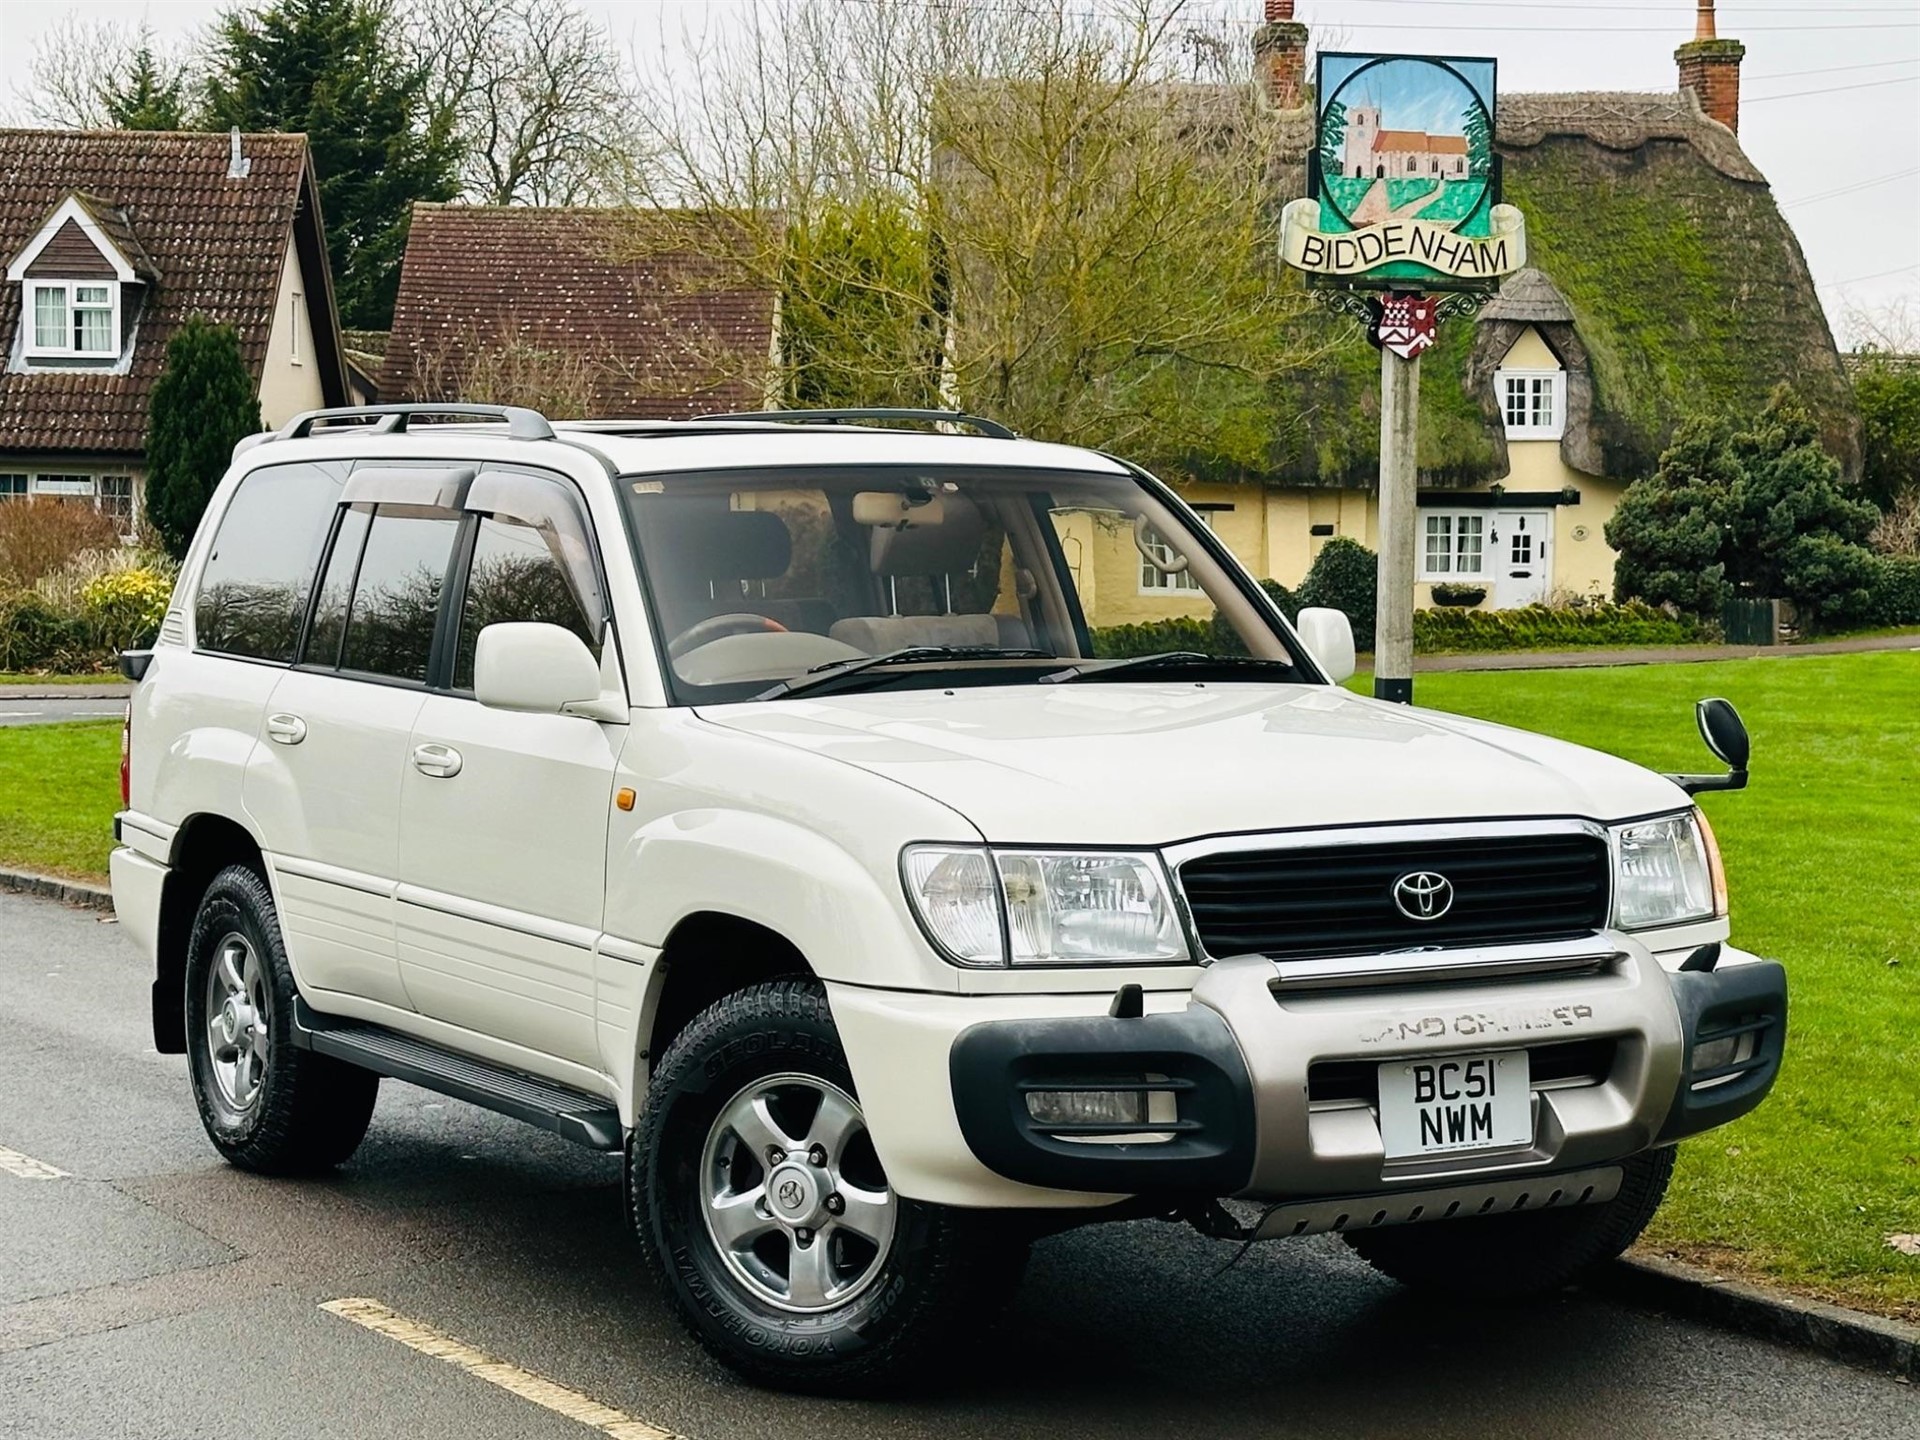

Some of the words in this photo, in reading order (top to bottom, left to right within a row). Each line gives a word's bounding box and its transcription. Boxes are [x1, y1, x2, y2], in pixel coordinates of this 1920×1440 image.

[1301, 225, 1508, 273] BIDDENHAM
[1413, 1059, 1495, 1103] BC51
[1420, 1102, 1493, 1146] NWM
